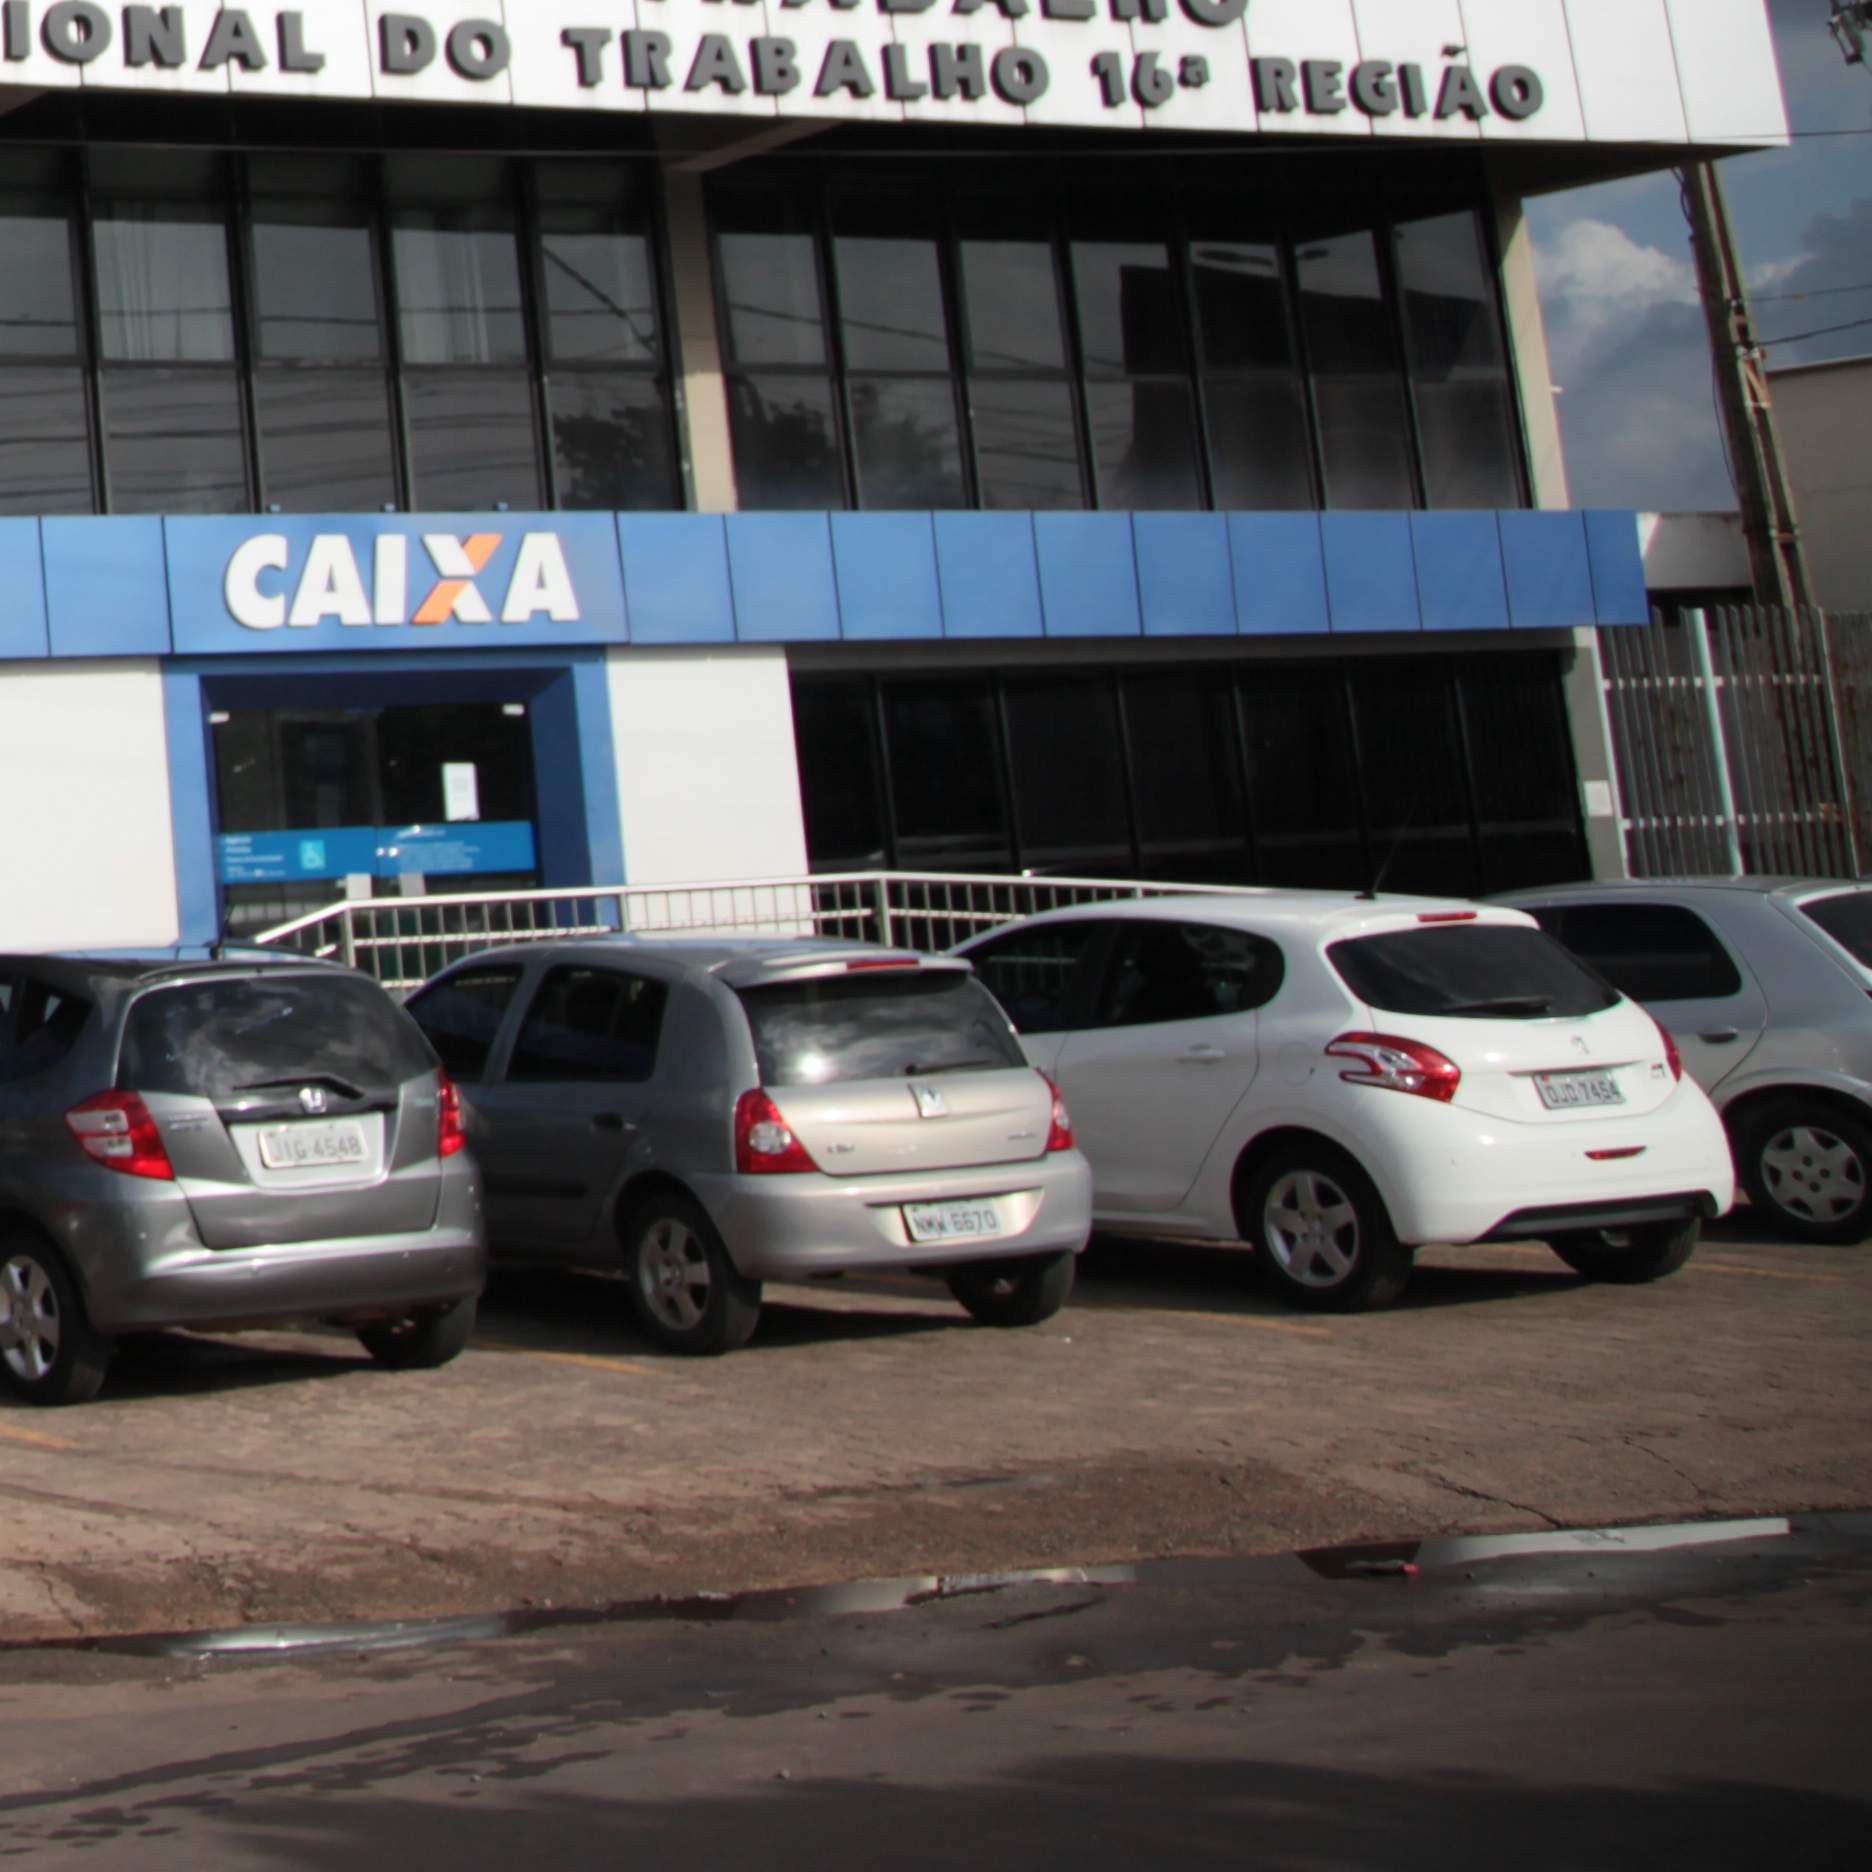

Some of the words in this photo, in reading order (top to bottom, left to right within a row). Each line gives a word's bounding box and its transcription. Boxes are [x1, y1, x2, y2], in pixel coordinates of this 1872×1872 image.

[378, 12, 511, 81] DO
[561, 27, 1051, 105] TRABALHO
[1250, 43, 1545, 122] REGIÃO
[223, 532, 581, 629] CAIXA
